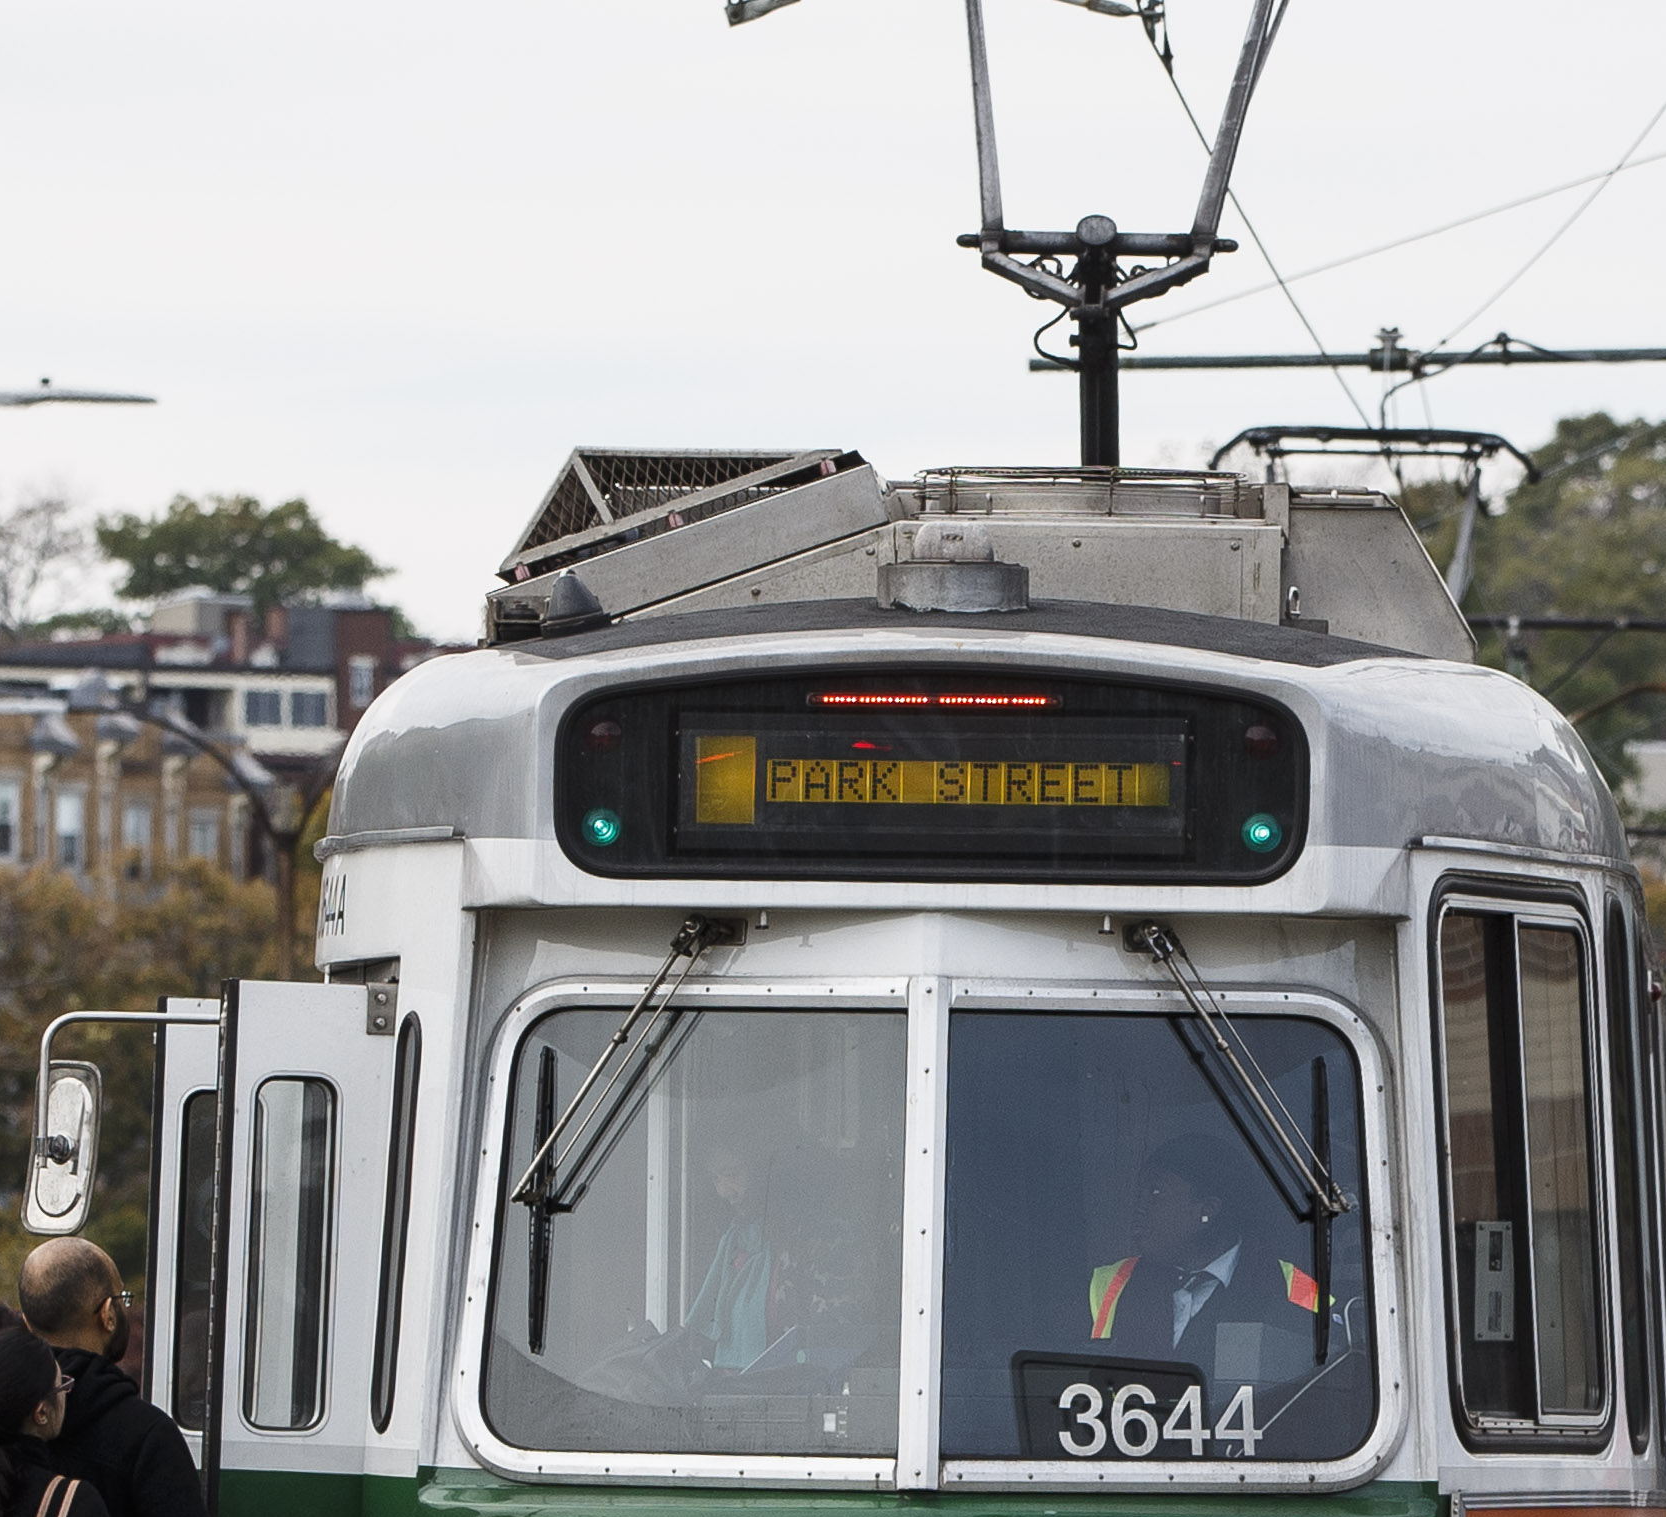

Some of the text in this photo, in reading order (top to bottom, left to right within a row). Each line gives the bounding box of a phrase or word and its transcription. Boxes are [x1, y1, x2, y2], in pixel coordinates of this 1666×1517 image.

[771, 760, 1133, 804] PARK STREET
[1058, 1383, 1263, 1457] 3644
